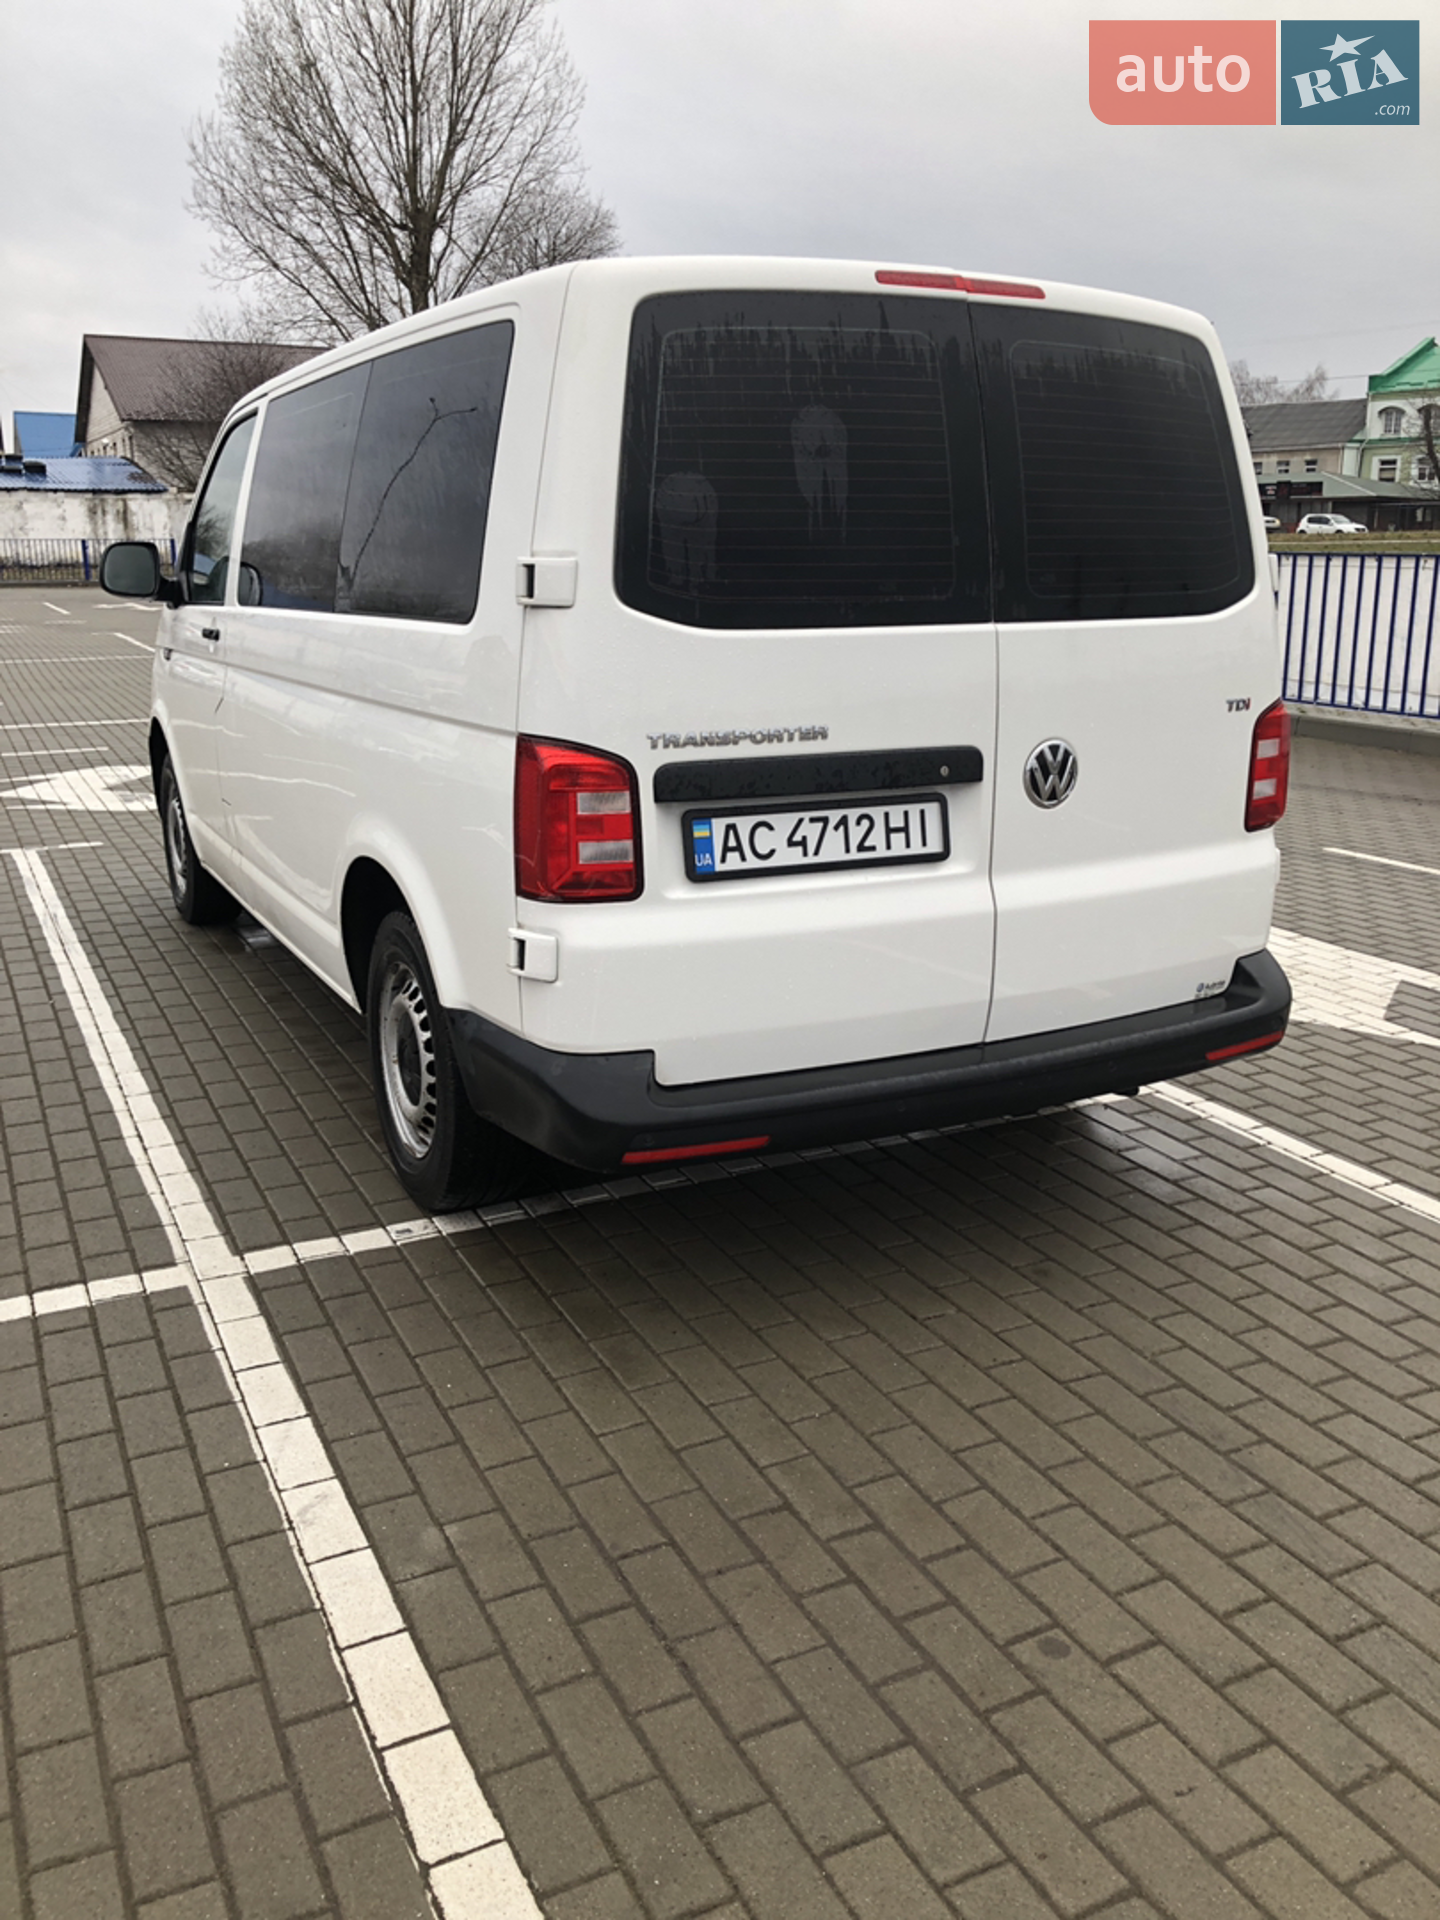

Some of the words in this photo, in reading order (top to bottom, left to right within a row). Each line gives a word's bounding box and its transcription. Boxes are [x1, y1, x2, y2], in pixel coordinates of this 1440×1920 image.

[1225, 697, 1252, 713] TDI
[646, 725, 829, 749] TRANSPORTER
[720, 820, 777, 864] AC
[786, 813, 877, 857] 4712
[883, 808, 928, 851] HI
[694, 853, 713, 867] UA
